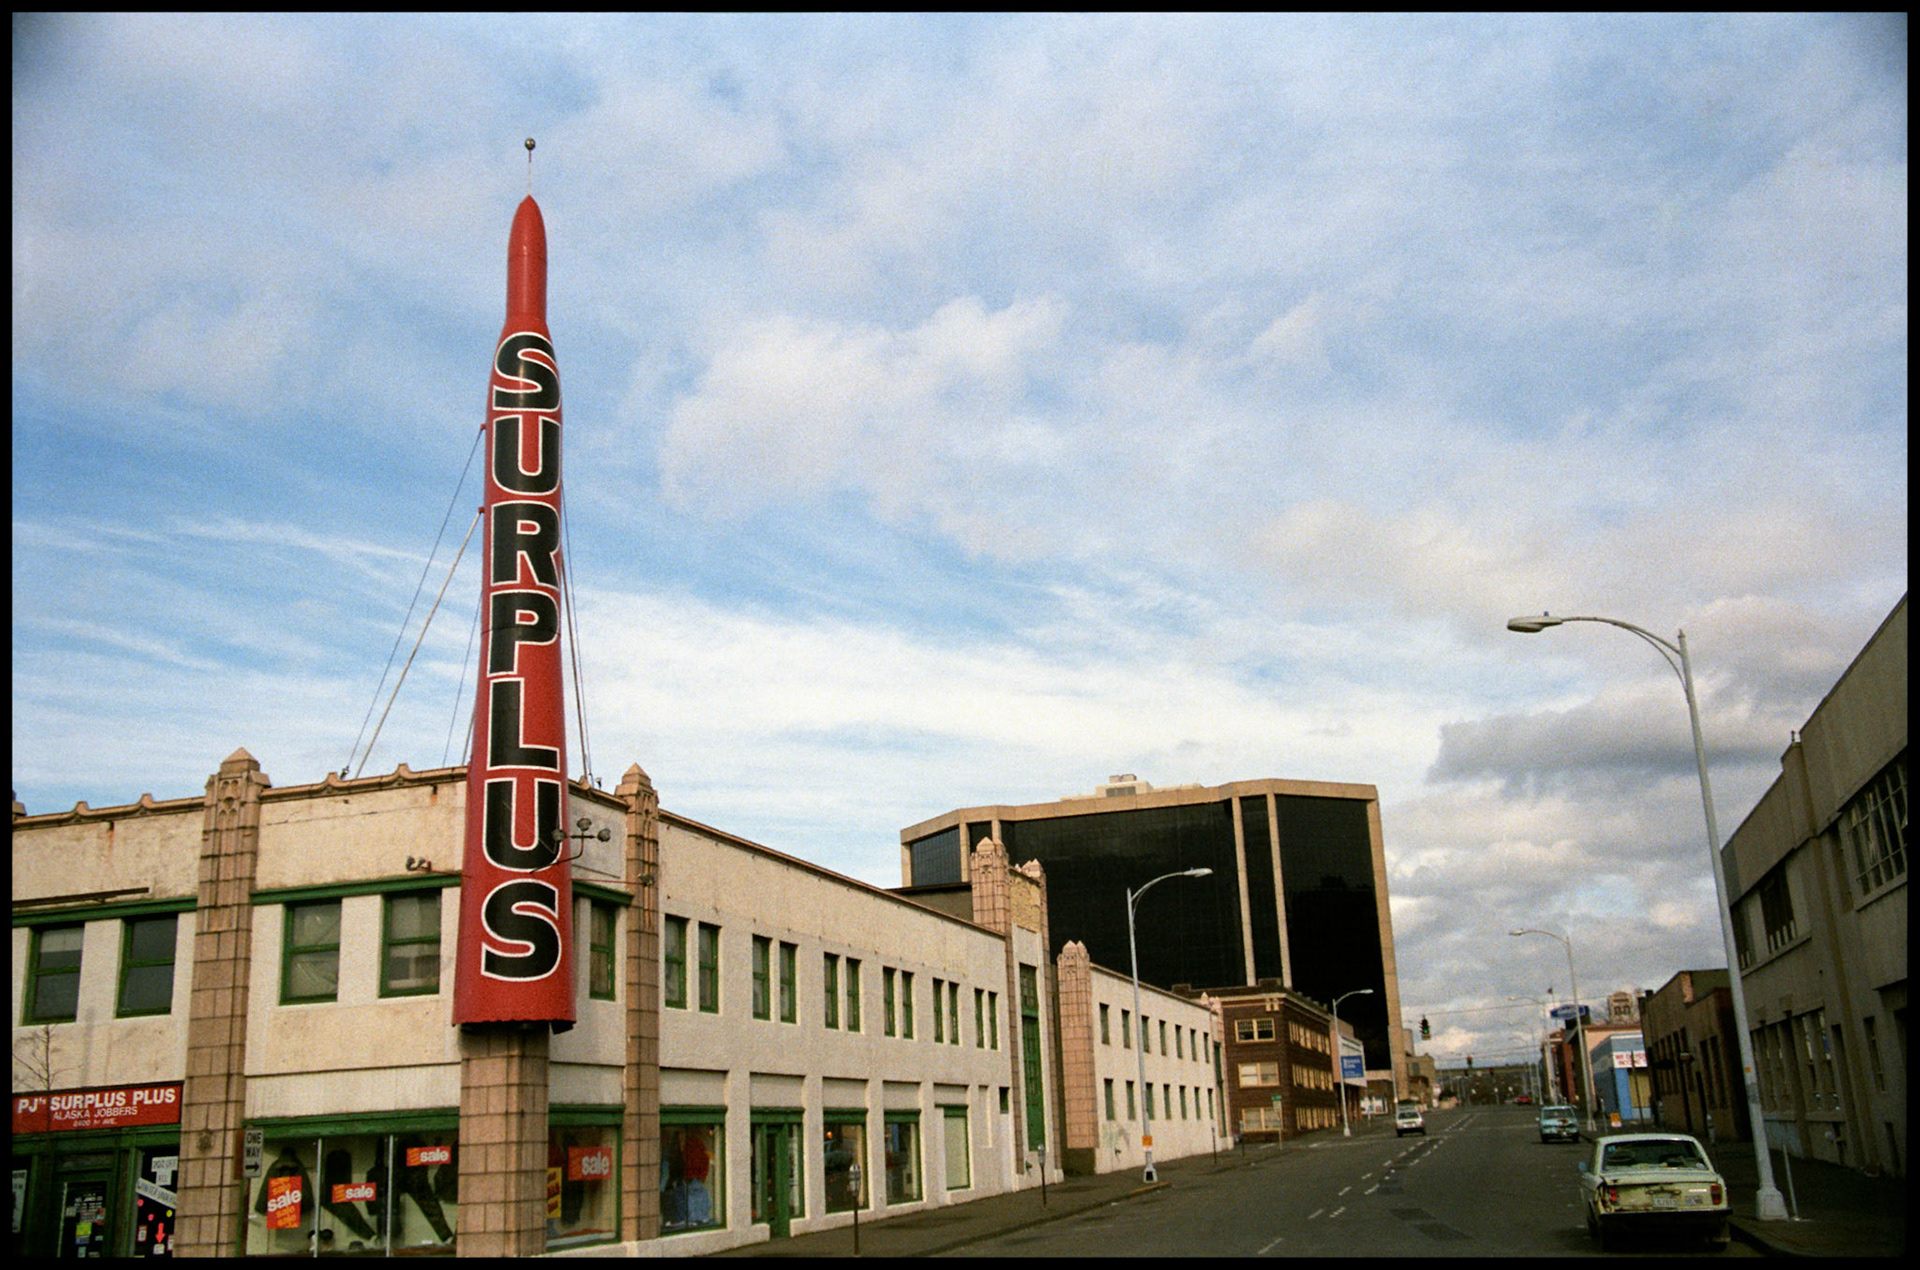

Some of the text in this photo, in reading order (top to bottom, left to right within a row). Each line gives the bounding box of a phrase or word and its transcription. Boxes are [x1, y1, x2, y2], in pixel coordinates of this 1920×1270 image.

[480, 330, 561, 982] SURPLUS
[50, 1091, 127, 1111] SURPLUS
[133, 1088, 176, 1106] PLUS
[52, 1106, 138, 1121] ALASKA JOBBERS
[246, 1132, 262, 1144] ONE
[245, 1147, 261, 1158] WAY
[420, 1148, 449, 1163] sale
[581, 1151, 610, 1175] sale
[345, 1185, 374, 1200] sale
[267, 1189, 302, 1212] sale
